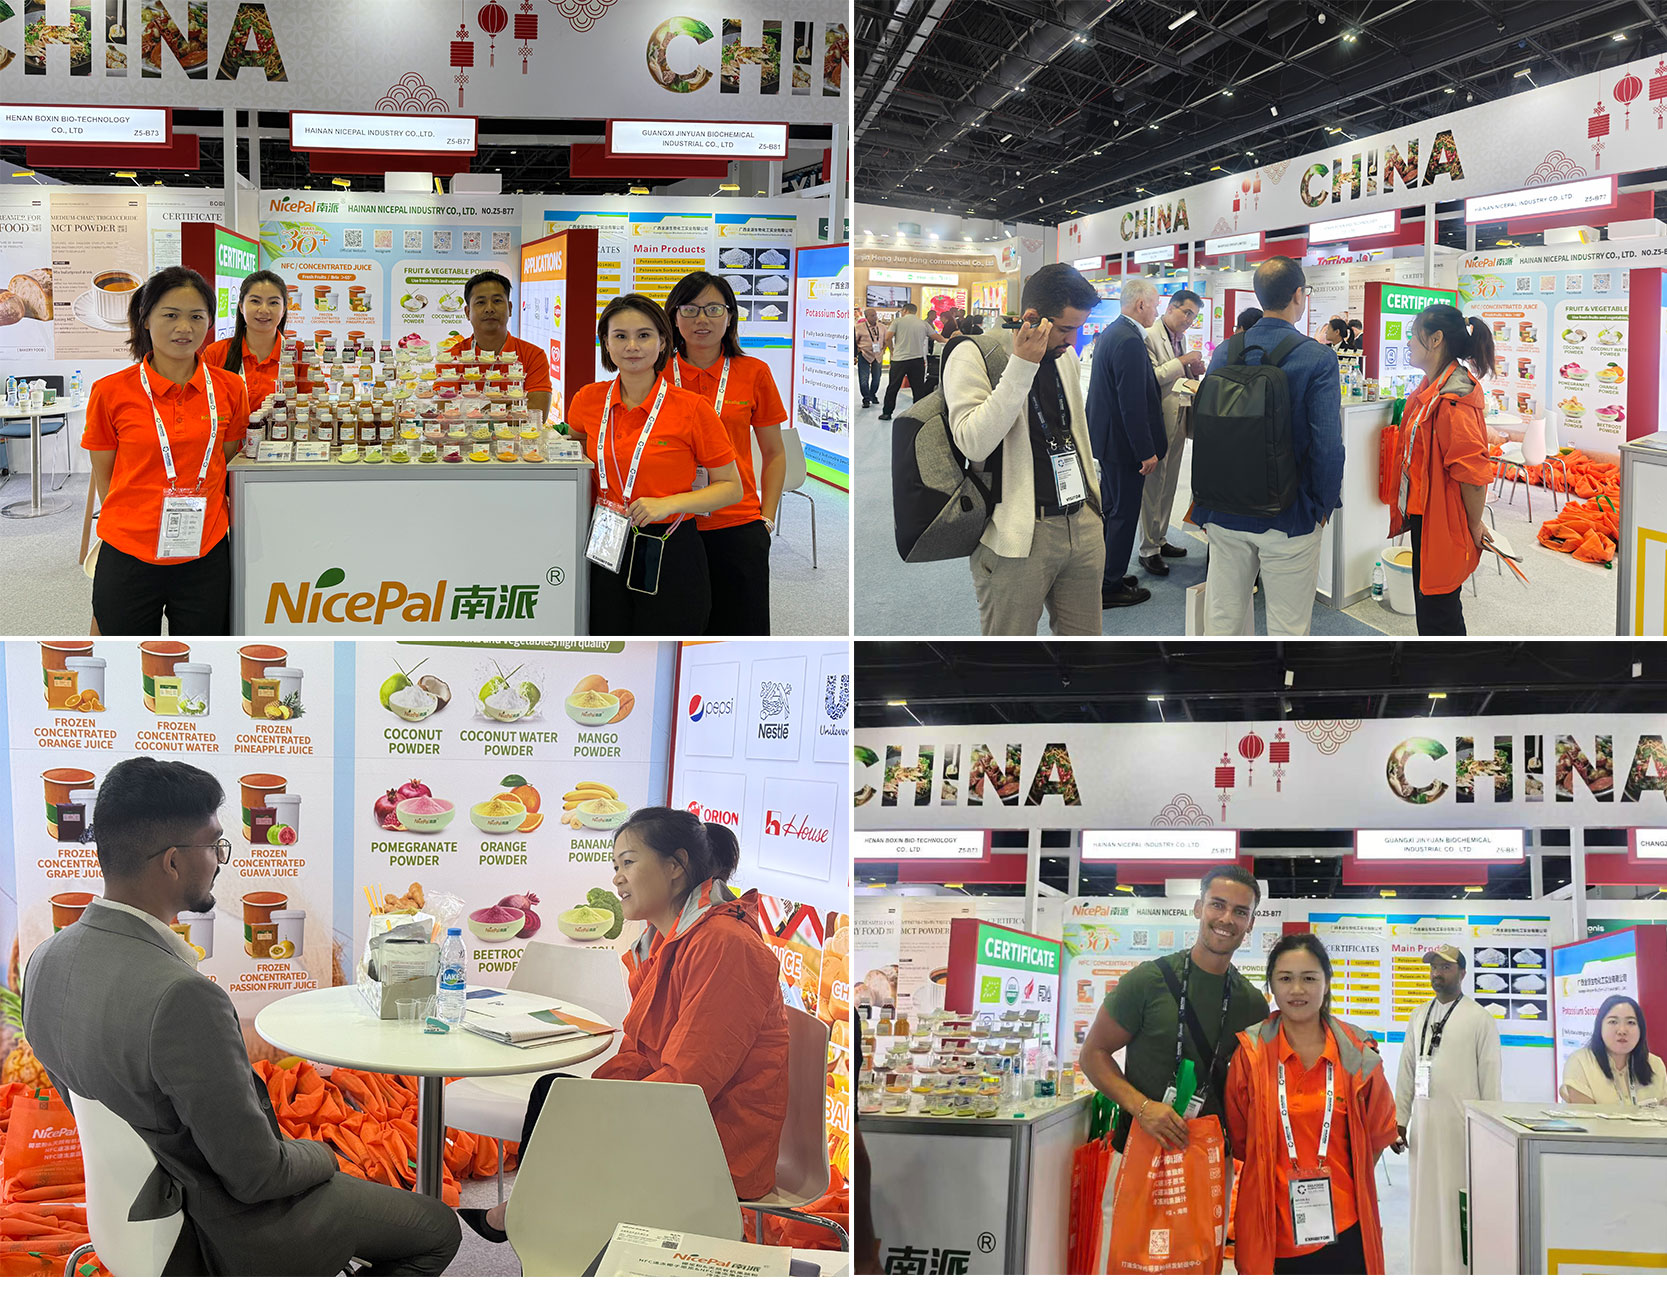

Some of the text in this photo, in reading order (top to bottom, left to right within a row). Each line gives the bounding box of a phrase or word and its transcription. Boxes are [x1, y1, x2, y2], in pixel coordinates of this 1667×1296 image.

[1300, 129, 1466, 208] CHINA
[270, 196, 316, 213] NicePal
[316, 202, 340, 213] 南派
[348, 204, 376, 213] HAINAN
[378, 205, 408, 214] NICEPAL
[409, 206, 445, 214] INDUSTRY
[462, 207, 478, 216] LTD.
[0, 223, 30, 232] FOOD
[51, 224, 116, 233] MCT POWDER
[162, 212, 222, 222] CERTIFICATE
[1120, 198, 1190, 242] CHINA
[218, 244, 256, 272] CERTIFICATE
[634, 244, 706, 254] Main Products
[872, 254, 892, 263] Heng
[908, 256, 928, 264] Long
[1570, 252, 1605, 260] INDUSTRY
[523, 250, 563, 275] APPLICATIONS
[1464, 256, 1496, 268] NicePal
[806, 308, 836, 318] Potassium
[264, 567, 447, 624] NicePal
[450, 584, 540, 620] 南派
[578, 641, 610, 651] quality
[705, 698, 734, 718] pepsi
[34, 718, 117, 750] FROZEN CONCENTRATED ORANGE JUICE
[134, 721, 220, 752] FROZEN CONCENTRATED COCONUT WATER
[234, 724, 314, 756] FROZEN CONCENTRATED PINEAPPLE JUICE
[384, 728, 443, 754] COCONUT POWDER
[758, 721, 790, 740] Nestlé
[460, 731, 558, 756] COCONUT WATER POWDER
[573, 732, 621, 758] MANGO POWDER
[1386, 735, 1667, 804] CHINA
[704, 808, 739, 826] ORION
[782, 814, 829, 844] House
[370, 842, 458, 866] POMEGRANATE POWDER
[479, 842, 528, 866] ORANGE POWDER
[568, 839, 614, 862] BANANA POWDER
[46, 850, 98, 879] FROZEN GRAPE
[232, 850, 306, 878] FROZEN CONCENTRATED GUAVA JUICE
[1072, 902, 1110, 917] NicePal
[1162, 908, 1188, 916] NICEPAL
[984, 938, 1055, 968] CERTIFICATE
[1392, 944, 1416, 952] Main
[230, 963, 317, 992] FROZEN CONCENTRATED PASSION FRUIT JUICE
[32, 1126, 76, 1139] NicePal
[672, 1252, 731, 1268] NicePal
